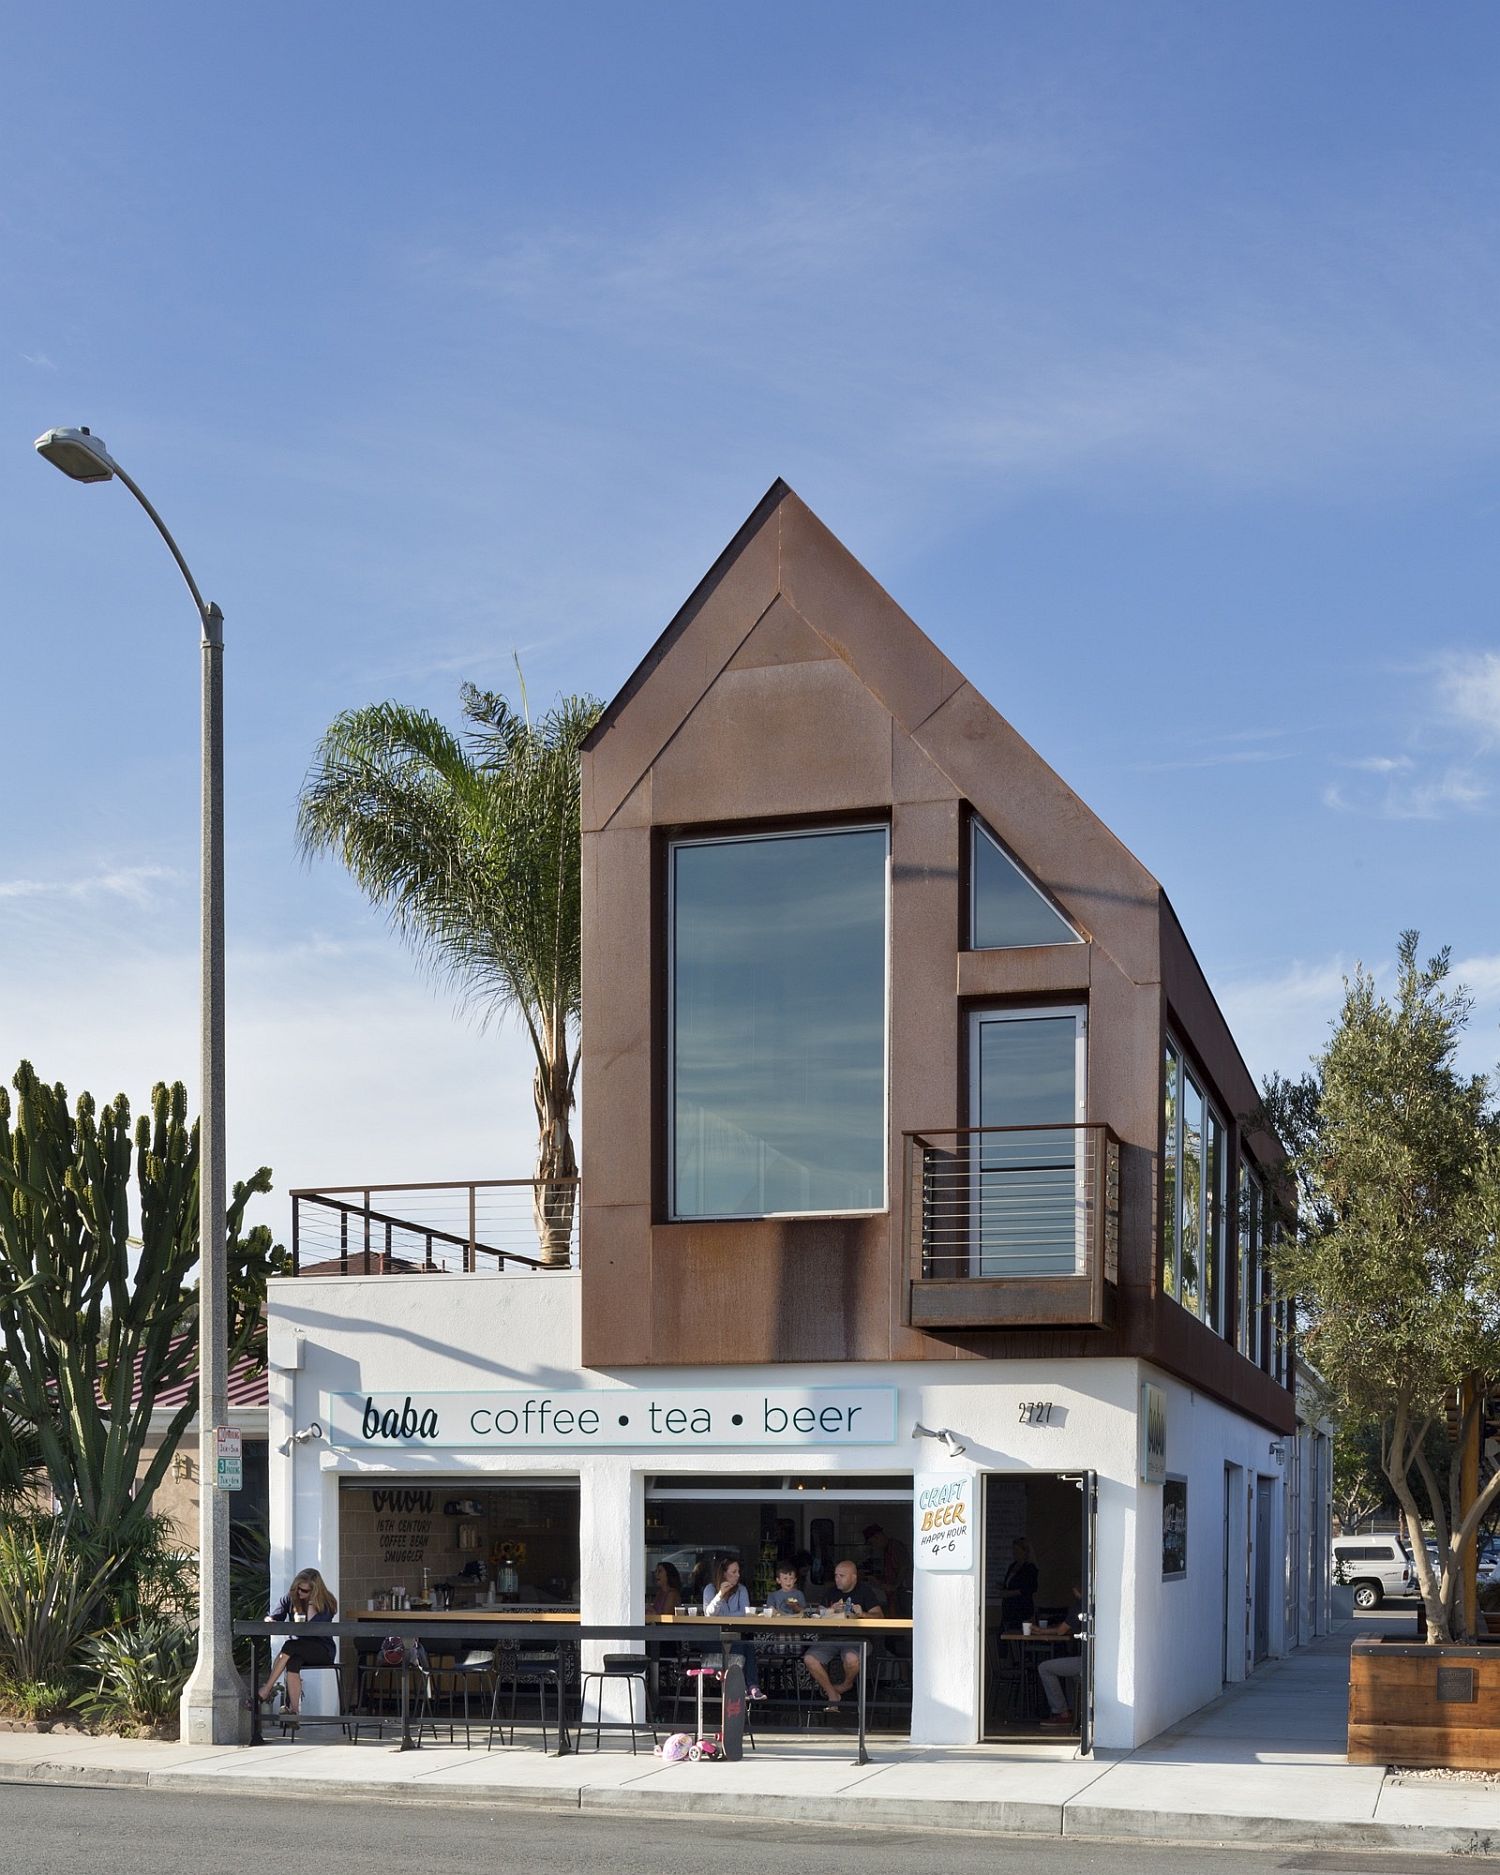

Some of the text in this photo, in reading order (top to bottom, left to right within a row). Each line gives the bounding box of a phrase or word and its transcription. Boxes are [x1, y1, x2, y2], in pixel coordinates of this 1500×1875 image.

[362, 1396, 864, 1439] baba coffee tea beer
[1018, 1401, 1053, 1424] 2727
[220, 1460, 225, 1473] 3
[919, 1478, 967, 1510] CRAFT
[398, 1519, 433, 1533] CENTURY
[921, 1502, 966, 1532] BEER
[380, 1534, 430, 1547] COFFEE BEAN
[920, 1525, 968, 1546] HAPPY HOUR
[384, 1550, 425, 1563] SMUGGLER
[931, 1540, 956, 1555] 4-6
